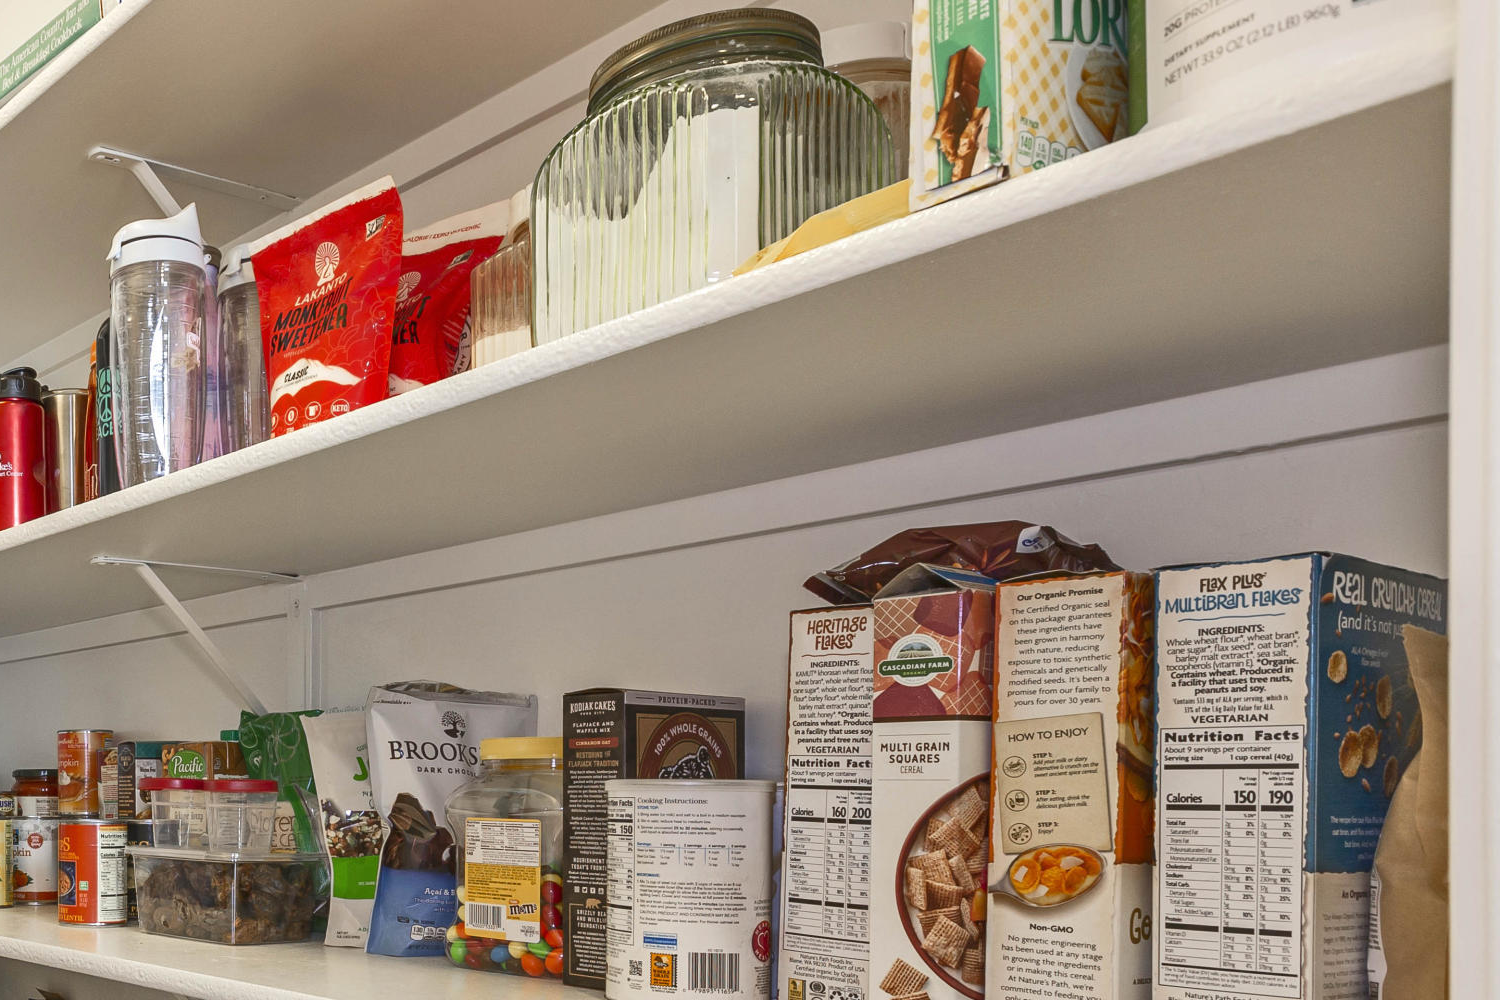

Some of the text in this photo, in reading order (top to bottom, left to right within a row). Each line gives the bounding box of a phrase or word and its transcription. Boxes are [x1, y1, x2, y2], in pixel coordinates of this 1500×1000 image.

[1164, 18, 1182, 36] 20G
[11, 39, 40, 66] American
[40, 17, 65, 44] Country
[22, 48, 50, 75] Breakfast
[51, 18, 83, 51] Cookbook
[1164, 13, 1255, 67] DIETARY SUPPLEMENT
[1165, 67, 1182, 86] NET
[1183, 60, 1200, 75] WT
[1226, 36, 1244, 53] OZ
[1303, 4, 1341, 20] 960g
[295, 272, 347, 307] LAKANTO
[273, 275, 352, 333] MONKFRUIT
[270, 304, 348, 357] SWEETENER
[284, 366, 309, 384] CLASSIC
[332, 404, 348, 412] KETO
[1232, 573, 1264, 590] PLUS
[1035, 591, 1066, 600] Organic
[1068, 587, 1104, 596] Promise
[1372, 577, 1415, 616] CRUNCHY
[1198, 625, 1265, 636] INGREDIENTS:
[810, 660, 860, 668] INGREDIENTS:
[570, 700, 616, 713] KODIAK CAKES
[658, 696, 717, 707] PROTEIN-PACKED
[1191, 714, 1269, 724] VEGETARIAN
[654, 723, 723, 759] 100% WHOLE GRAINS
[1008, 727, 1089, 742] HOW TO ENJOY
[1164, 730, 1300, 743] Nutrition Facts
[805, 746, 860, 754] VEGETARIAN
[880, 741, 950, 752] MULTI GRAIN
[171, 755, 204, 774] Pacific
[791, 759, 840, 768] Nutrition
[889, 753, 940, 764] SQUARES
[417, 766, 443, 774] DARK
[900, 765, 924, 774] CEREAL
[637, 797, 708, 806] Cooking Instructions:
[1166, 790, 1293, 804] Calories 150 190
[791, 806, 871, 820] Calories 160 200
[1030, 923, 1074, 934] Non-GMO
